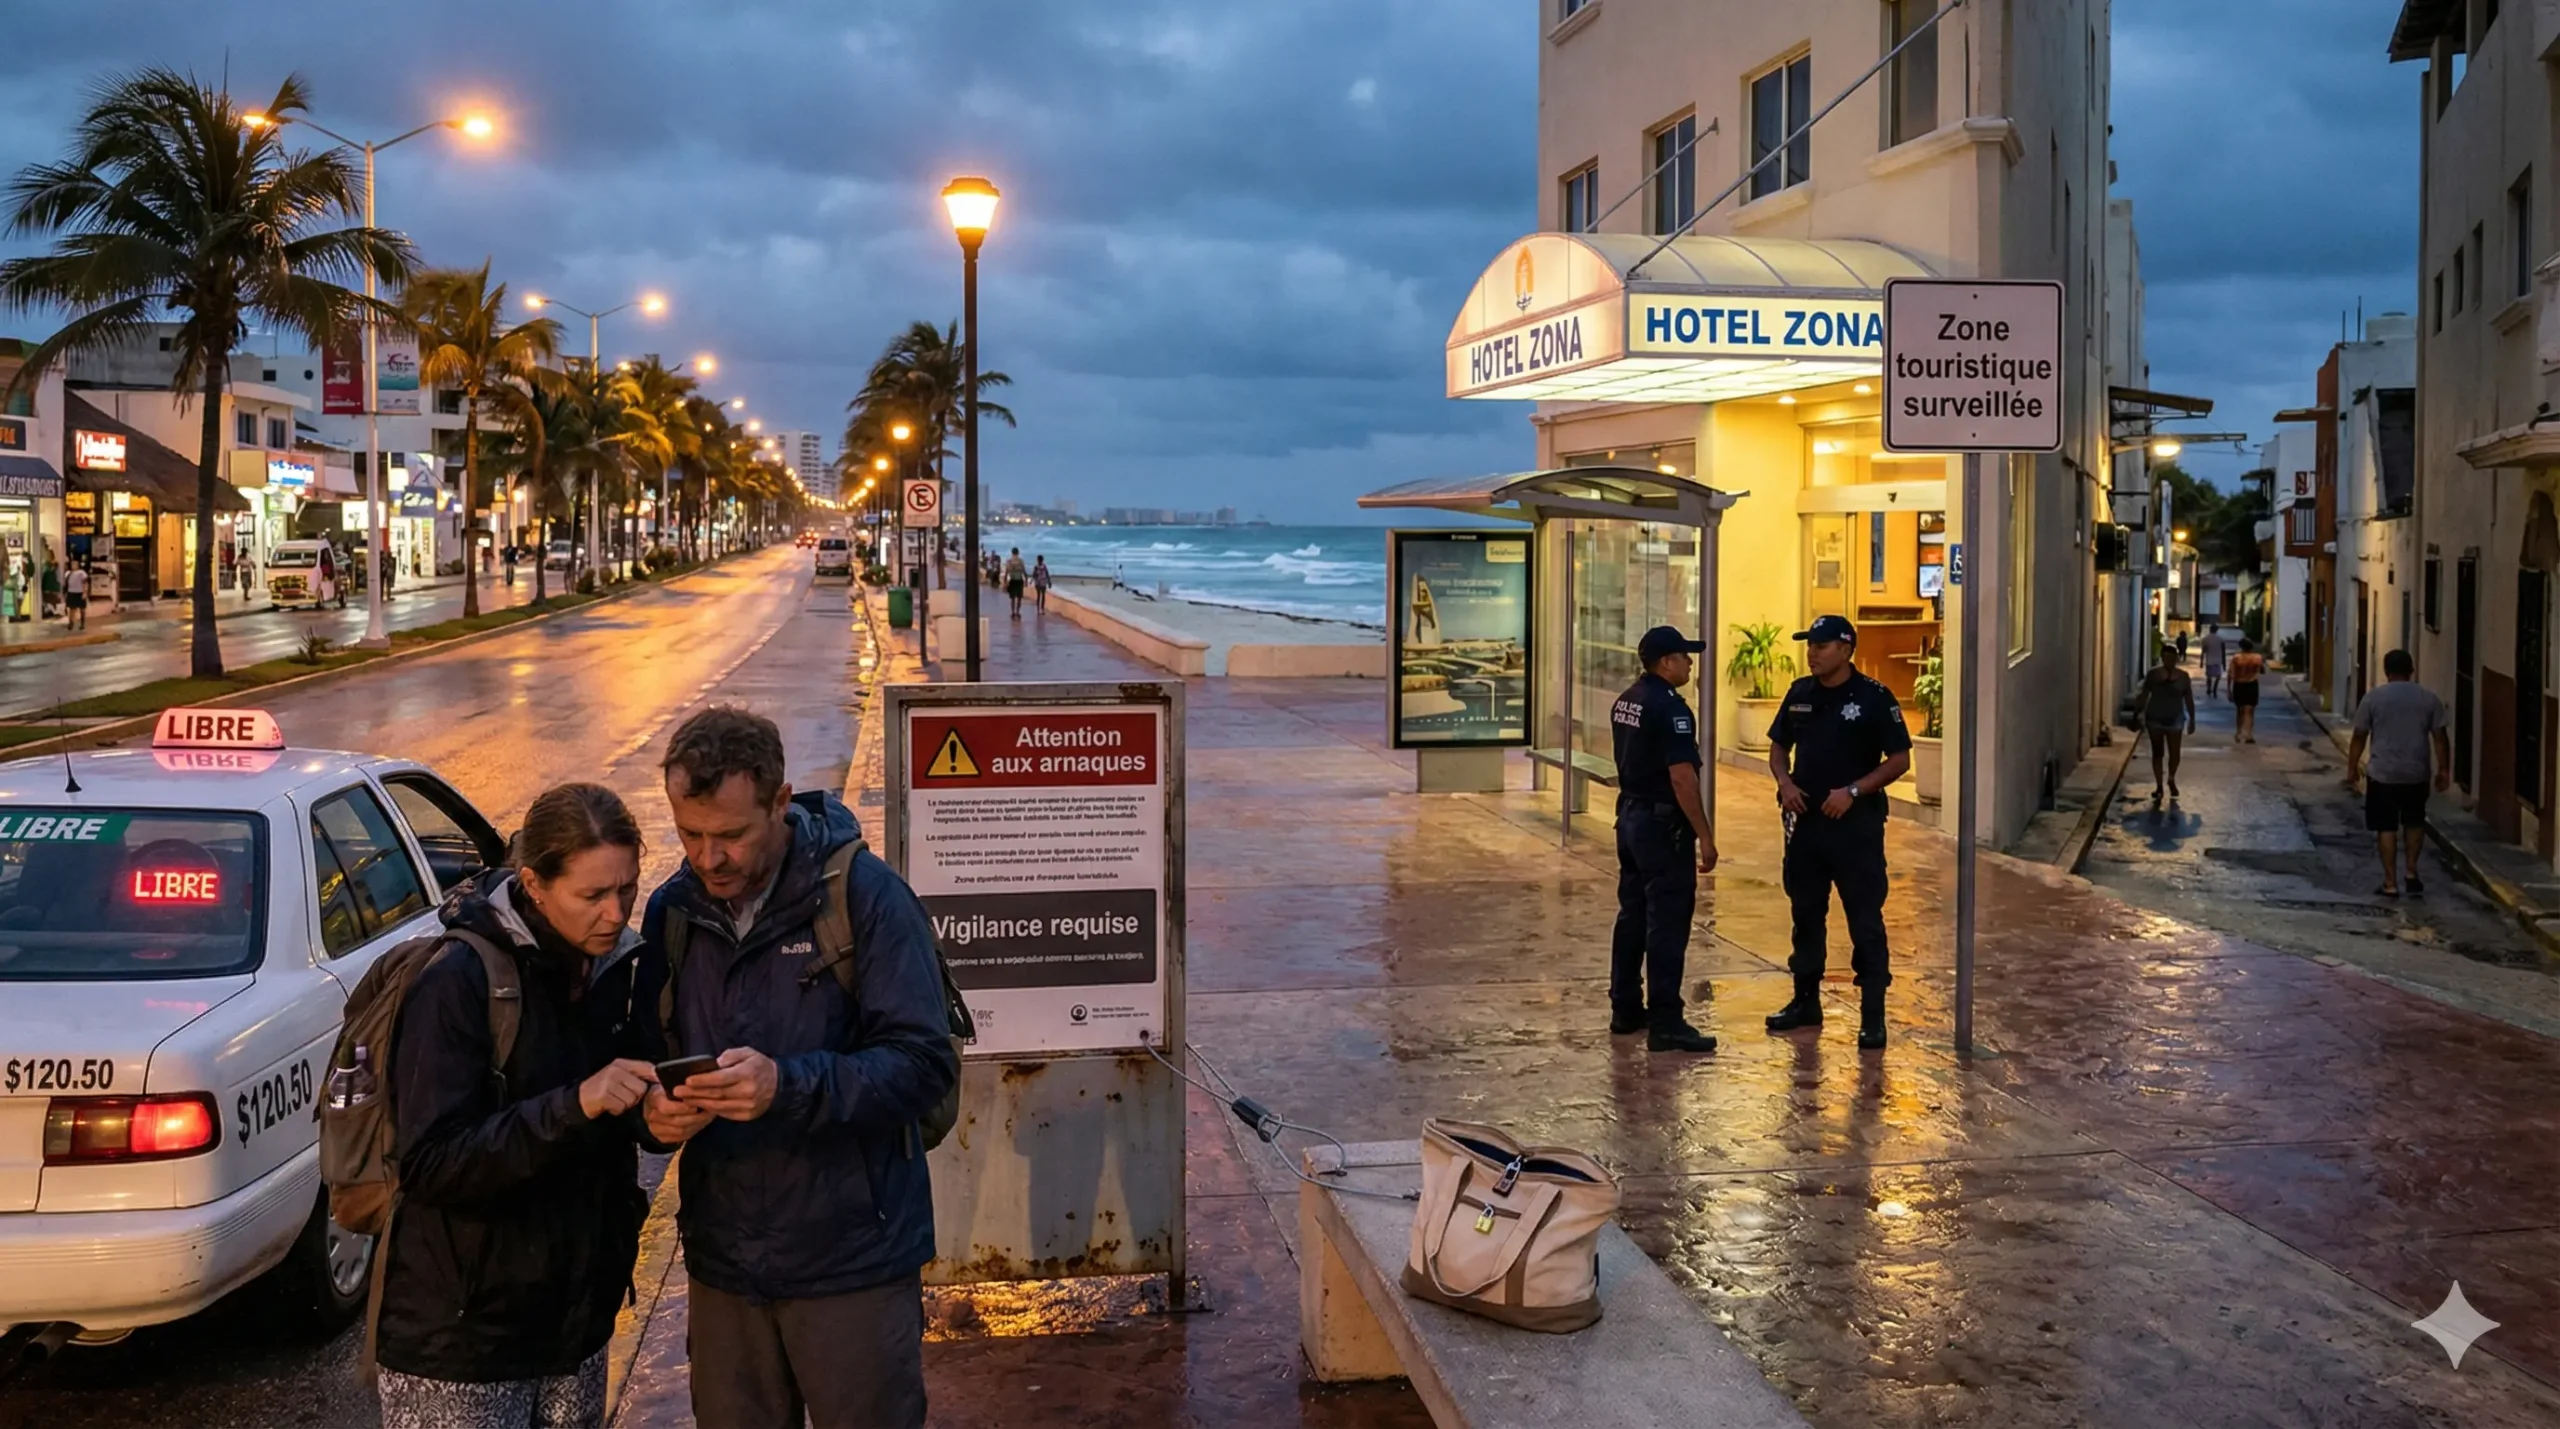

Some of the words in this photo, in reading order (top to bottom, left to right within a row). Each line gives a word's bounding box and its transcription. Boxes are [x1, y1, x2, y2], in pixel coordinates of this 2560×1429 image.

[1646, 307, 1771, 344] HOTEL
[1784, 311, 1883, 346] ZONA
[1937, 313, 2010, 341] Zone
[1471, 334, 1523, 385] HOTEL
[1529, 315, 1583, 369] ZONA
[1896, 352, 2052, 385] touristique
[1904, 391, 2043, 418] surveillée
[167, 715, 255, 741] LIBRE
[1016, 726, 1121, 748] Attention
[991, 756, 1032, 774] aux
[1039, 752, 1146, 776] arnaques
[0, 816, 108, 841] LIBRE
[134, 870, 219, 899] LIBRE
[931, 914, 1043, 946] Vigilance
[1050, 911, 1139, 941] requise
[5, 1058, 114, 1094] $120.50
[237, 1058, 313, 1149] $120.50
